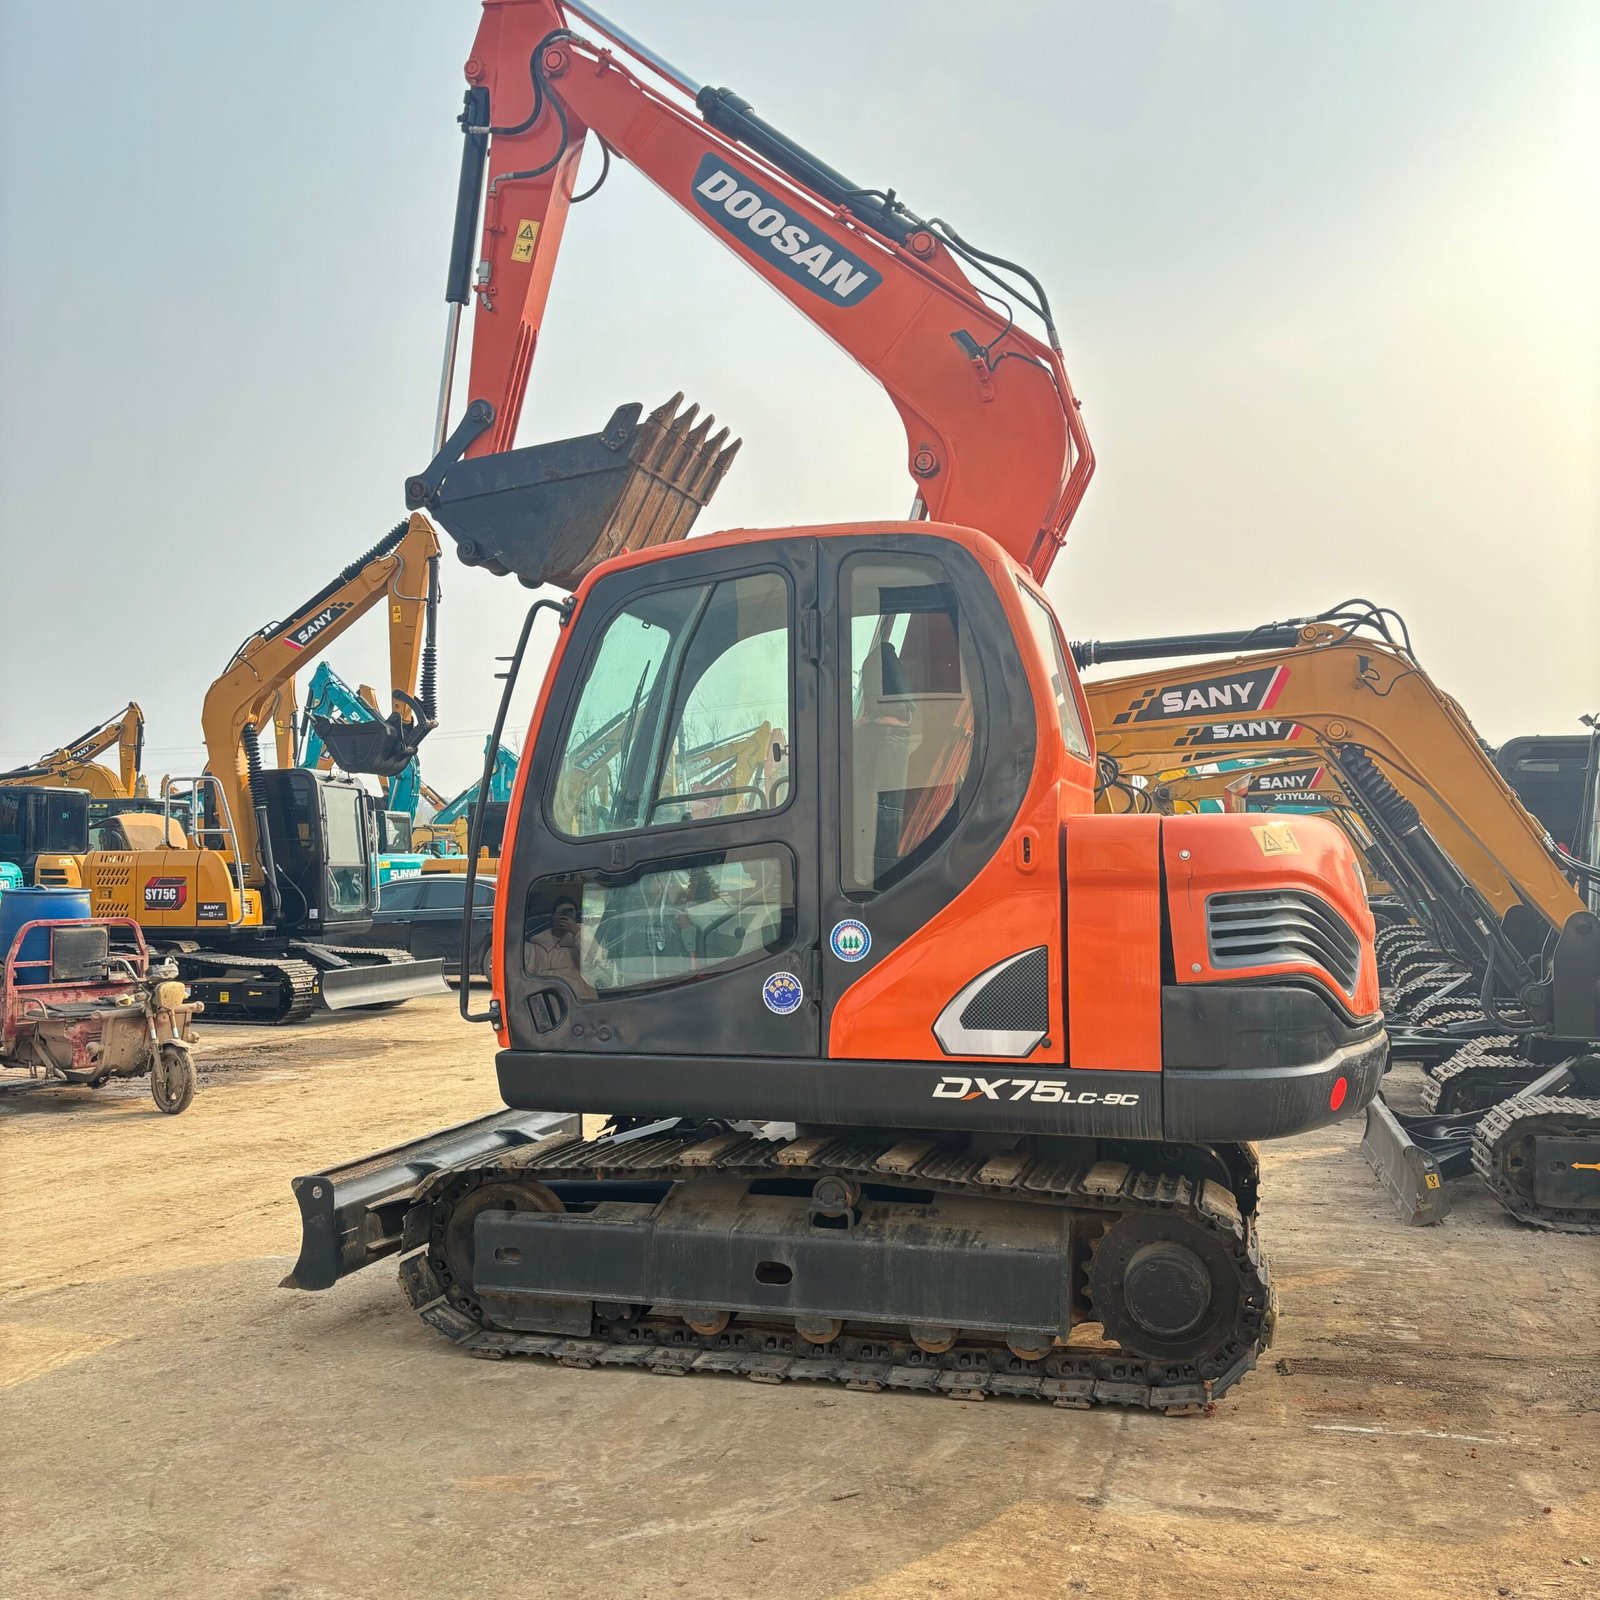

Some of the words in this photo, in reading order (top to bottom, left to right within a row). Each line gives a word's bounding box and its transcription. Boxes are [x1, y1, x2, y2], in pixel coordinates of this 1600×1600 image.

[697, 170, 868, 297] DOOSAN
[298, 609, 332, 643] SANY
[1162, 681, 1254, 713] SANY
[1213, 721, 1282, 739] SANY
[582, 744, 607, 769] SANY
[1259, 775, 1307, 789] SANY
[145, 888, 177, 900] SY75C
